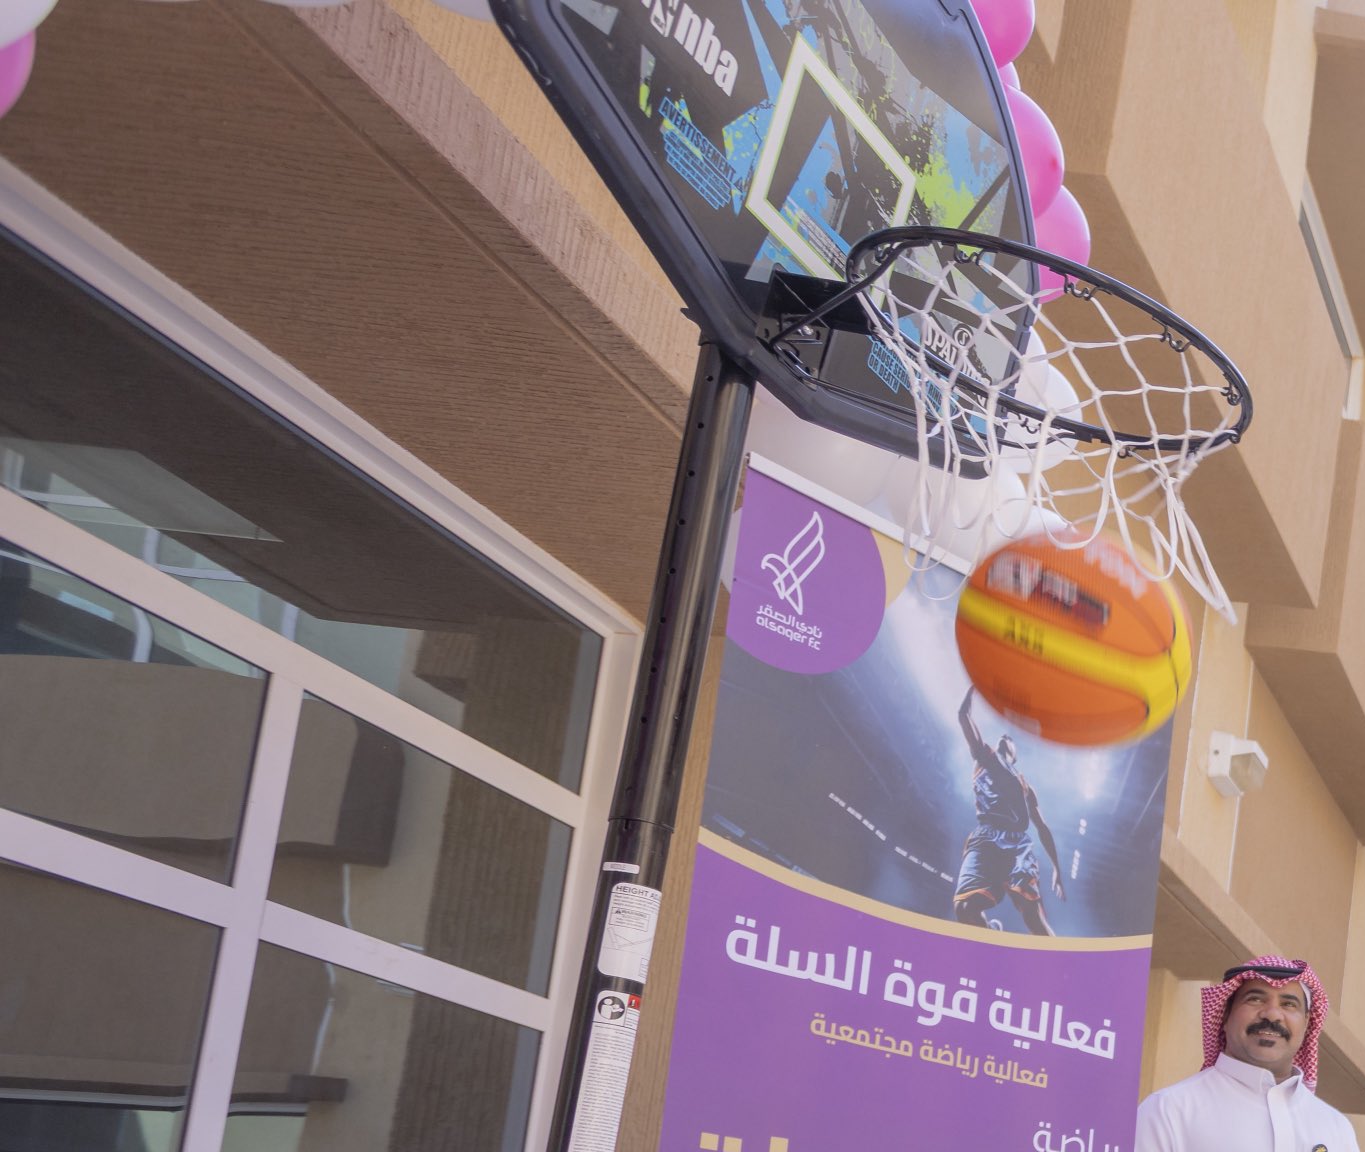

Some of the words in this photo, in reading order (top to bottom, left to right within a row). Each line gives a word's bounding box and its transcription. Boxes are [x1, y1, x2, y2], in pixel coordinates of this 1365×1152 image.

[673, 3, 739, 97] nba
[662, 101, 737, 181] AVERTISSEMENT
[869, 354, 878, 371] OR
[879, 364, 899, 391] DEATH
[873, 343, 894, 369] CAUSE
[756, 605, 795, 626] الصقر
[756, 616, 807, 643] alsaqer
[796, 621, 822, 638] نادي
[616, 886, 649, 896] HEIGHT
[726, 915, 872, 995] السلة
[884, 960, 978, 1026] قوة
[811, 1013, 913, 1058] مجتمعية
[987, 988, 1116, 1059] فعالية
[920, 1040, 979, 1078] رياضة
[984, 1055, 1048, 1088] فعالية
